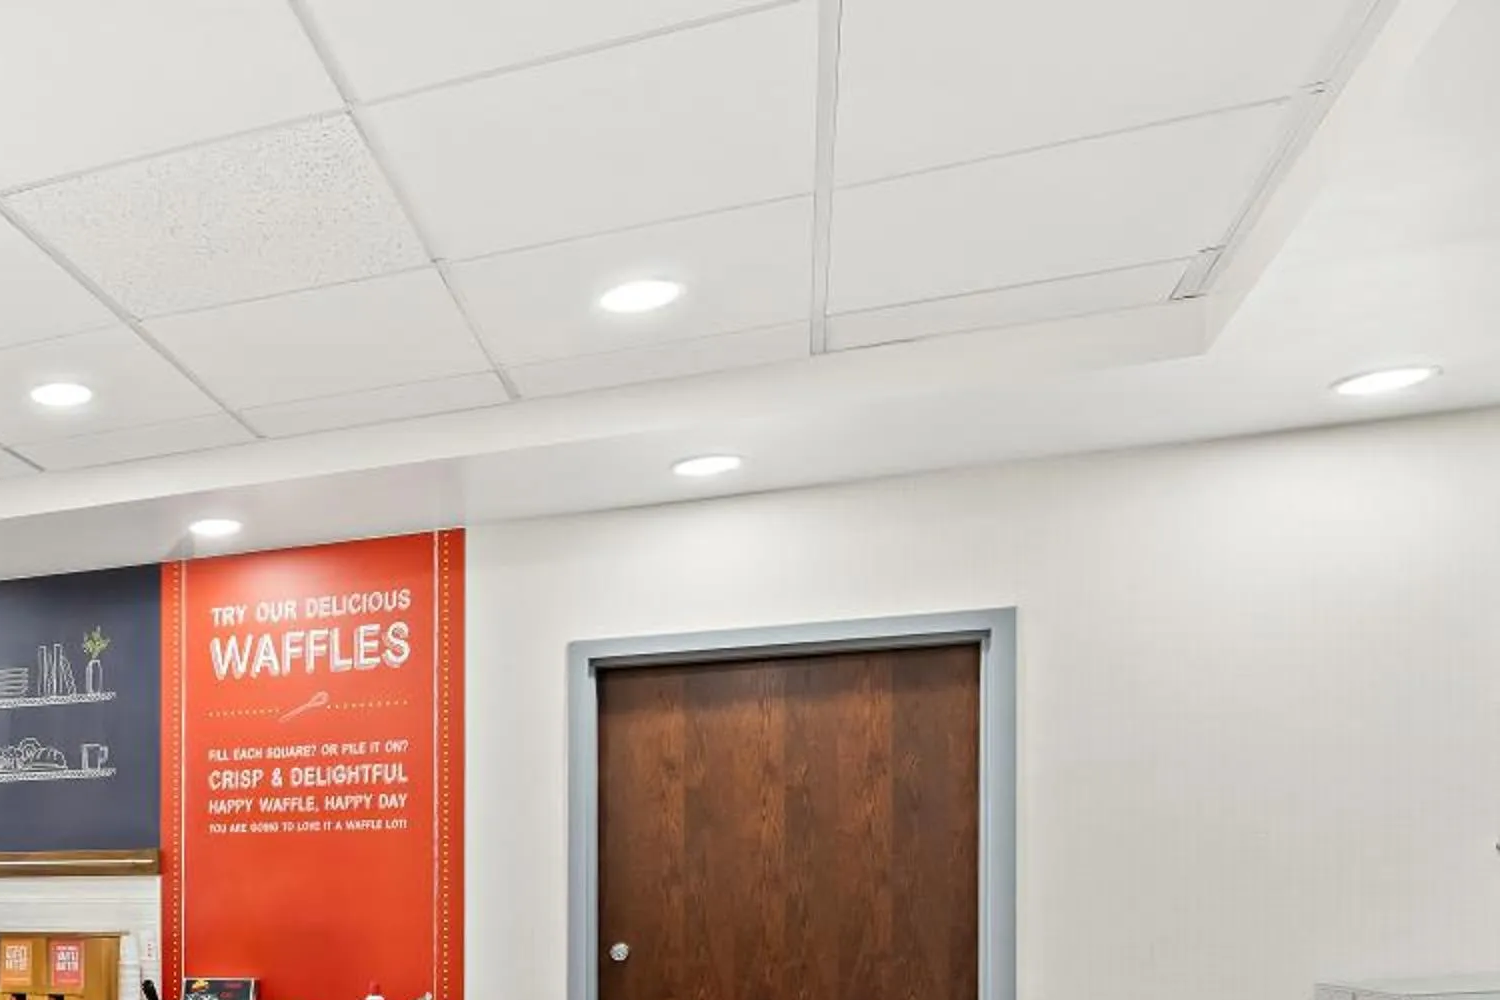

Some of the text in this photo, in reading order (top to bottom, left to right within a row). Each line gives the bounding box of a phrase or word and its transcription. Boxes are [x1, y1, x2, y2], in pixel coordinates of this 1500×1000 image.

[211, 588, 411, 627] TRY OUR DELICIOUS
[210, 621, 411, 680] WAFFLES
[208, 740, 409, 761] FILL EACH SQUARE? OR PILE IT ON?
[209, 762, 409, 790] CRISP & DELIGHTFUL
[208, 799, 253, 814] HAPPY
[324, 794, 373, 811] HAPPY
[378, 793, 408, 809] DAY
[230, 822, 247, 833] ARE
[250, 821, 279, 832] GOING
[282, 821, 295, 832] TO
[345, 819, 382, 830] WAFFLE
